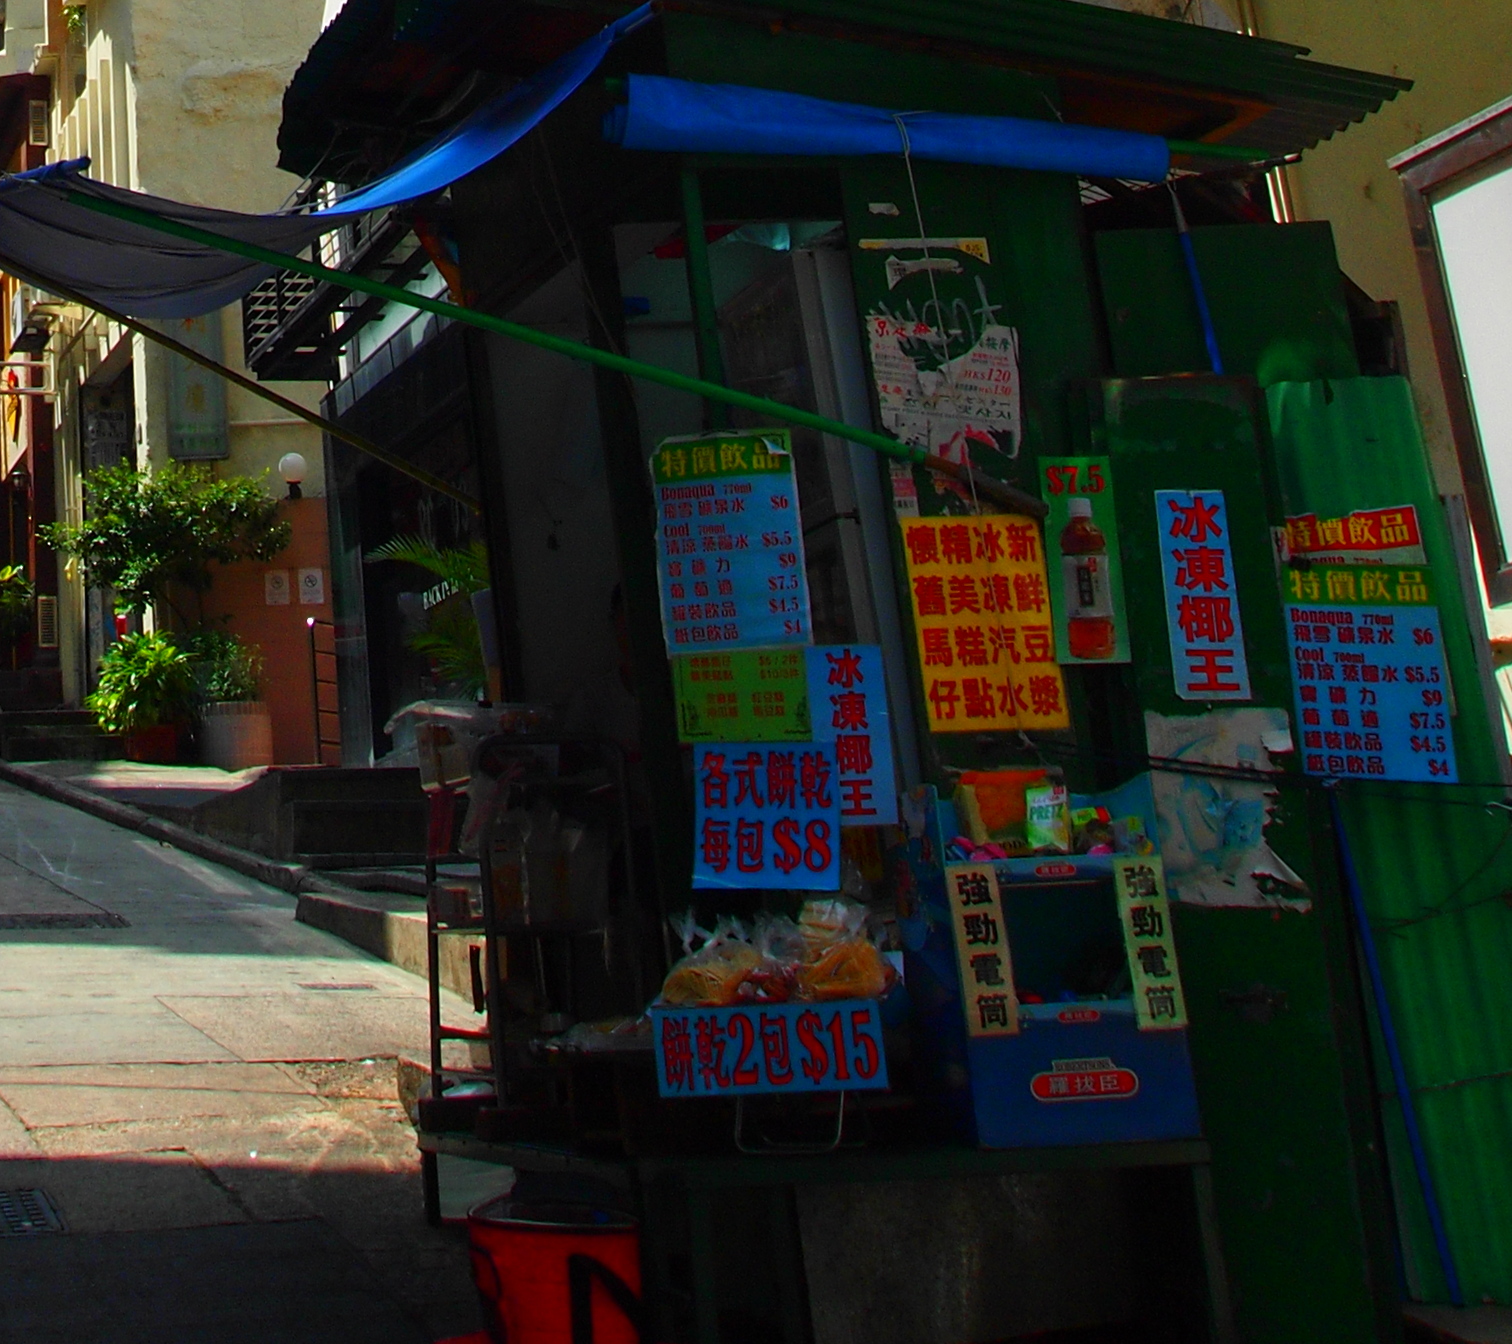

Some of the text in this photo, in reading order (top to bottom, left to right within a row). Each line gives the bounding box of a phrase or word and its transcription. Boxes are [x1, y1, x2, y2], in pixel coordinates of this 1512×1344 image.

[659, 442, 782, 479] 特價飲品
[1045, 464, 1106, 496] $7.5
[661, 483, 715, 501] Bonaqua
[770, 495, 789, 510] $6
[761, 530, 792, 548] $5.5
[1285, 512, 1411, 549] 特價飲品
[767, 575, 799, 592] $7.5
[1289, 569, 1429, 603] 特價飲品
[1166, 496, 1240, 692] 冰凍椰王
[768, 597, 800, 614] $4.5
[1290, 608, 1353, 626] Bonaqua
[784, 619, 802, 635] $4
[1412, 627, 1434, 646] $6
[1294, 645, 1324, 662] Cool
[1405, 665, 1440, 684] $5.5
[1421, 688, 1443, 707] $9
[1409, 711, 1446, 730] $7.5
[825, 648, 877, 816] 冰凍椰王
[1410, 735, 1447, 754] $4.5
[1428, 758, 1450, 776] $4
[701, 750, 832, 809] 各式餅乾
[956, 872, 1009, 1029] 強勁電筒
[1123, 864, 1176, 1020] 強勁電筒
